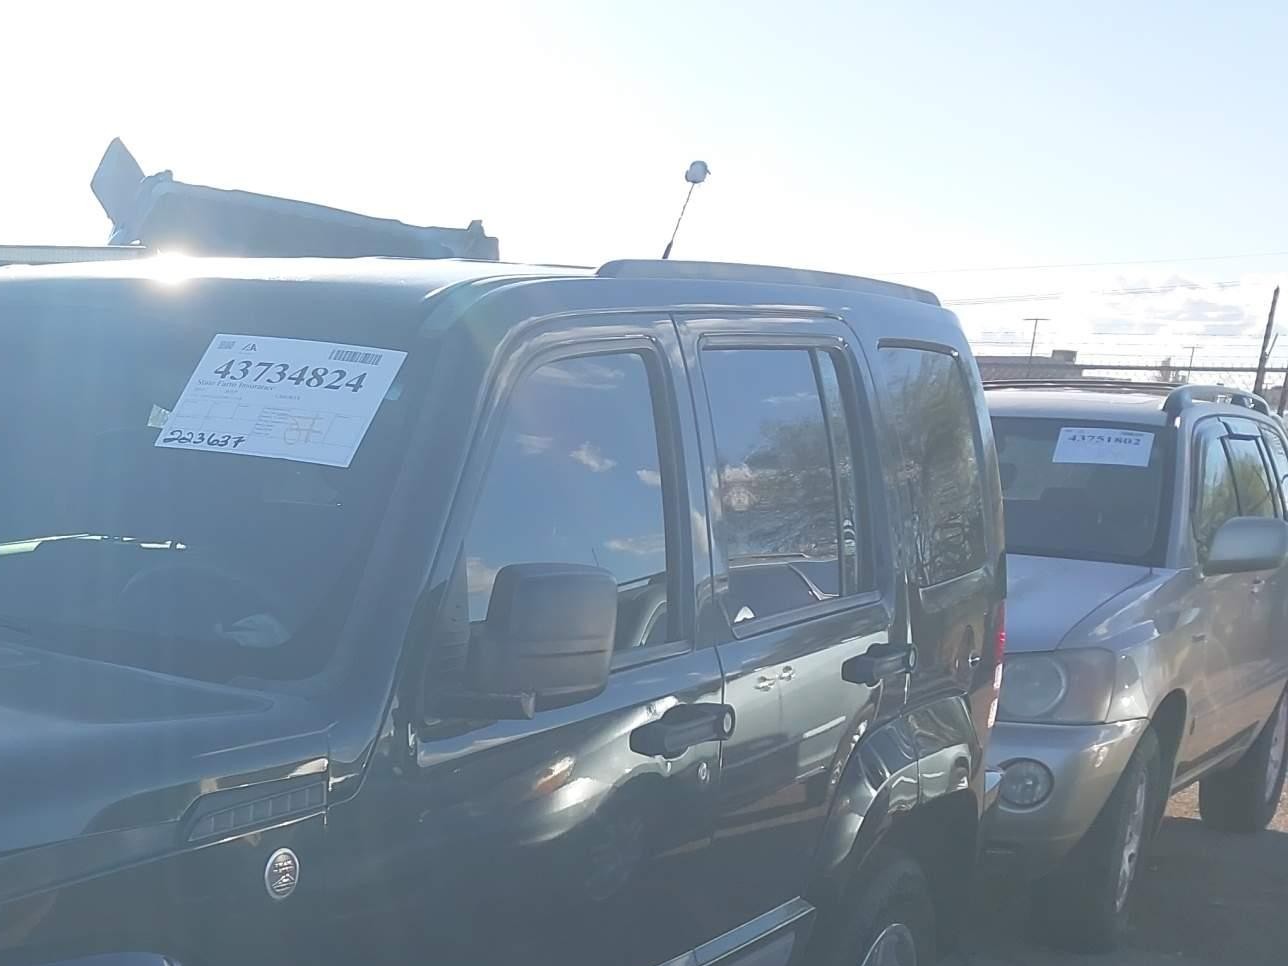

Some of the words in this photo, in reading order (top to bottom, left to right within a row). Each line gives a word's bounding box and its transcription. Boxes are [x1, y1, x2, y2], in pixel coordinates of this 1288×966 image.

[214, 358, 368, 393] 43734824
[216, 379, 236, 389] Farm
[238, 380, 275, 391] Insurance
[163, 430, 246, 448] 223637
